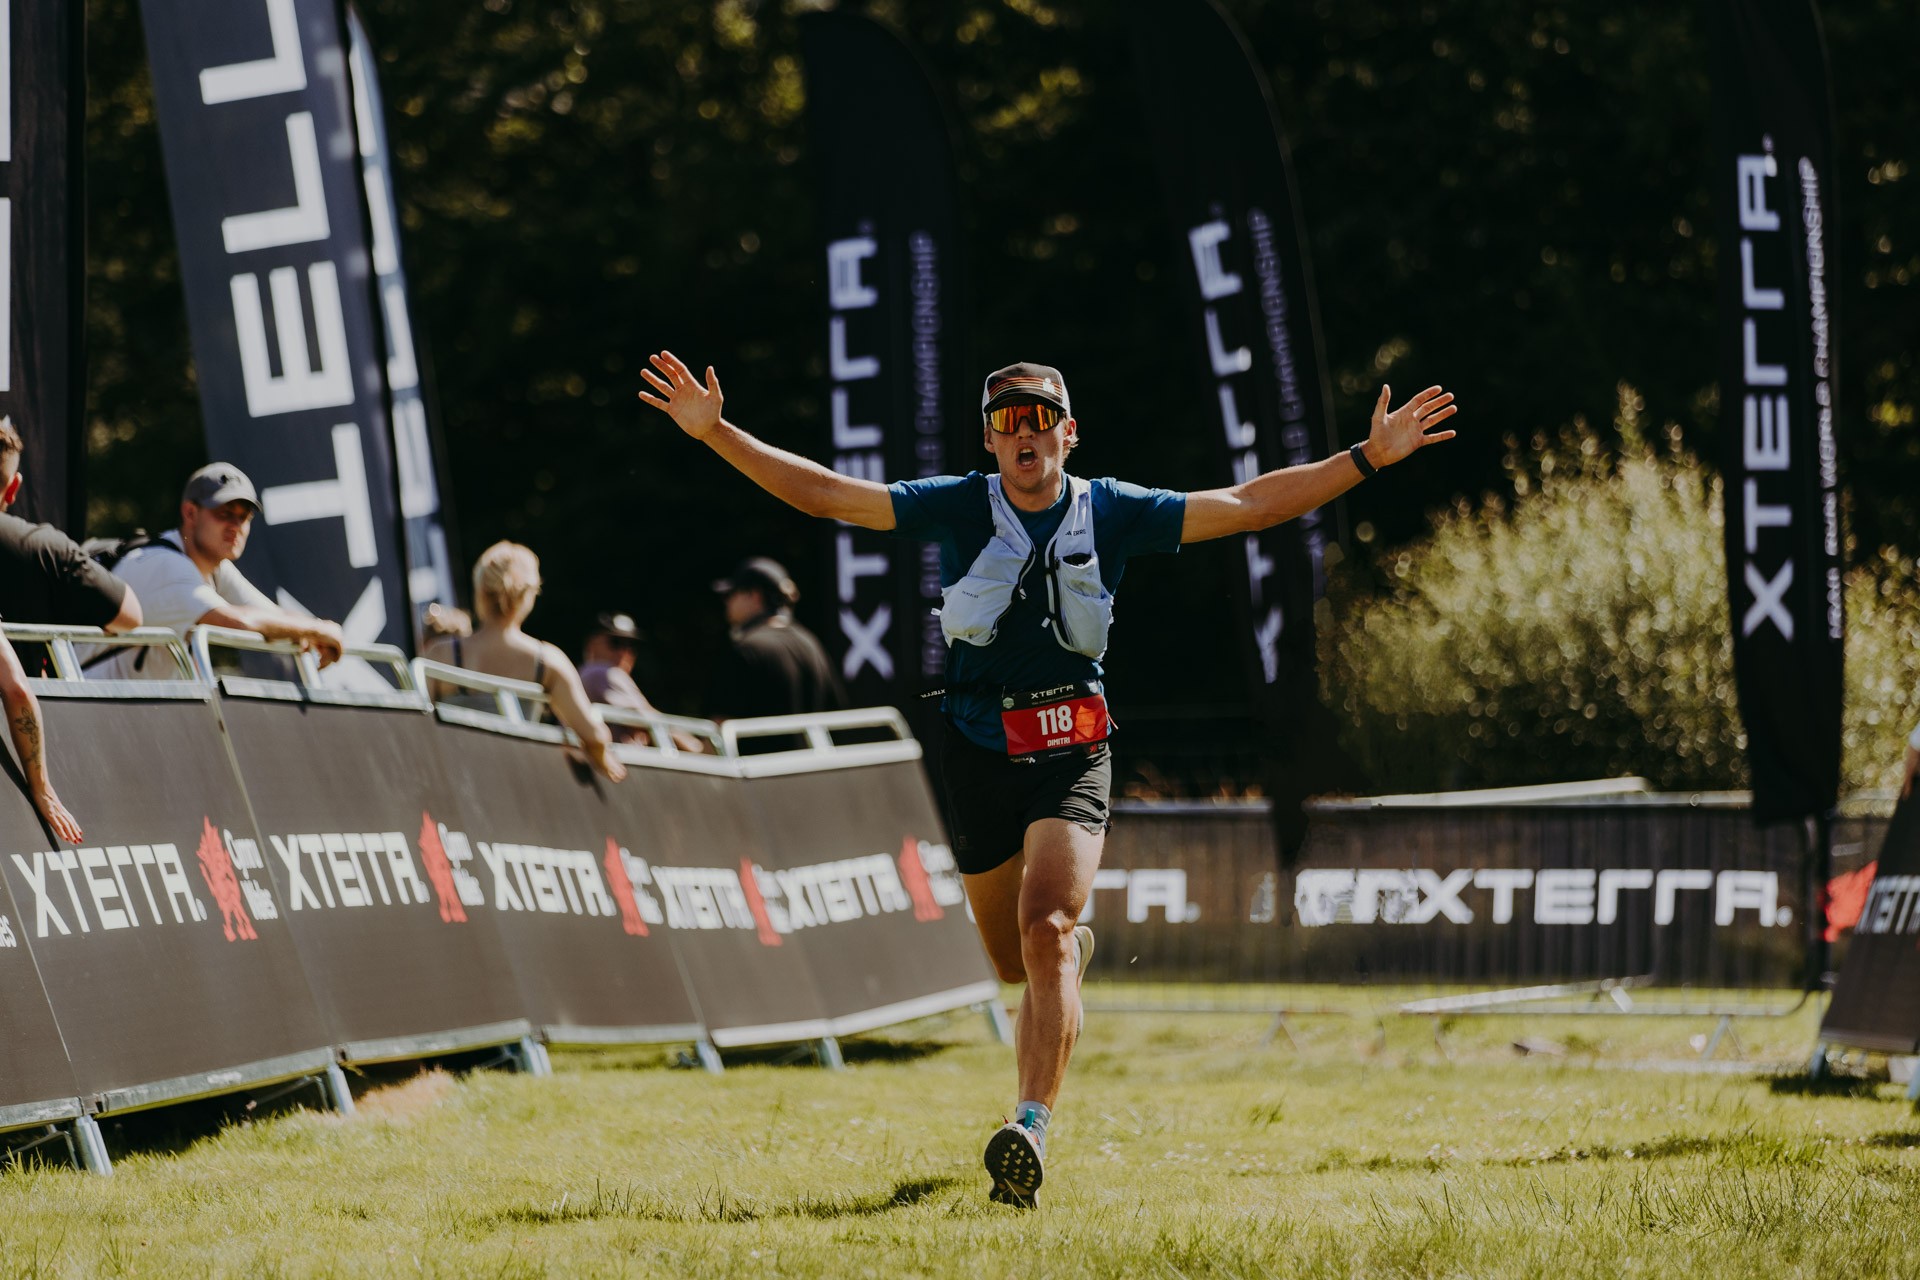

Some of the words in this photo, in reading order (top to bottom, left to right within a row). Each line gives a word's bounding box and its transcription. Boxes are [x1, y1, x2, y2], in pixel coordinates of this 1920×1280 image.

[1737, 155, 1794, 642] XTERRA
[1031, 684, 1074, 699] XTERRA
[1036, 705, 1073, 736] 118
[1047, 737, 1071, 747] DIMITRI
[11, 843, 203, 938] XTERRA
[269, 832, 427, 911] XTERRA
[477, 842, 615, 916] XTERRA
